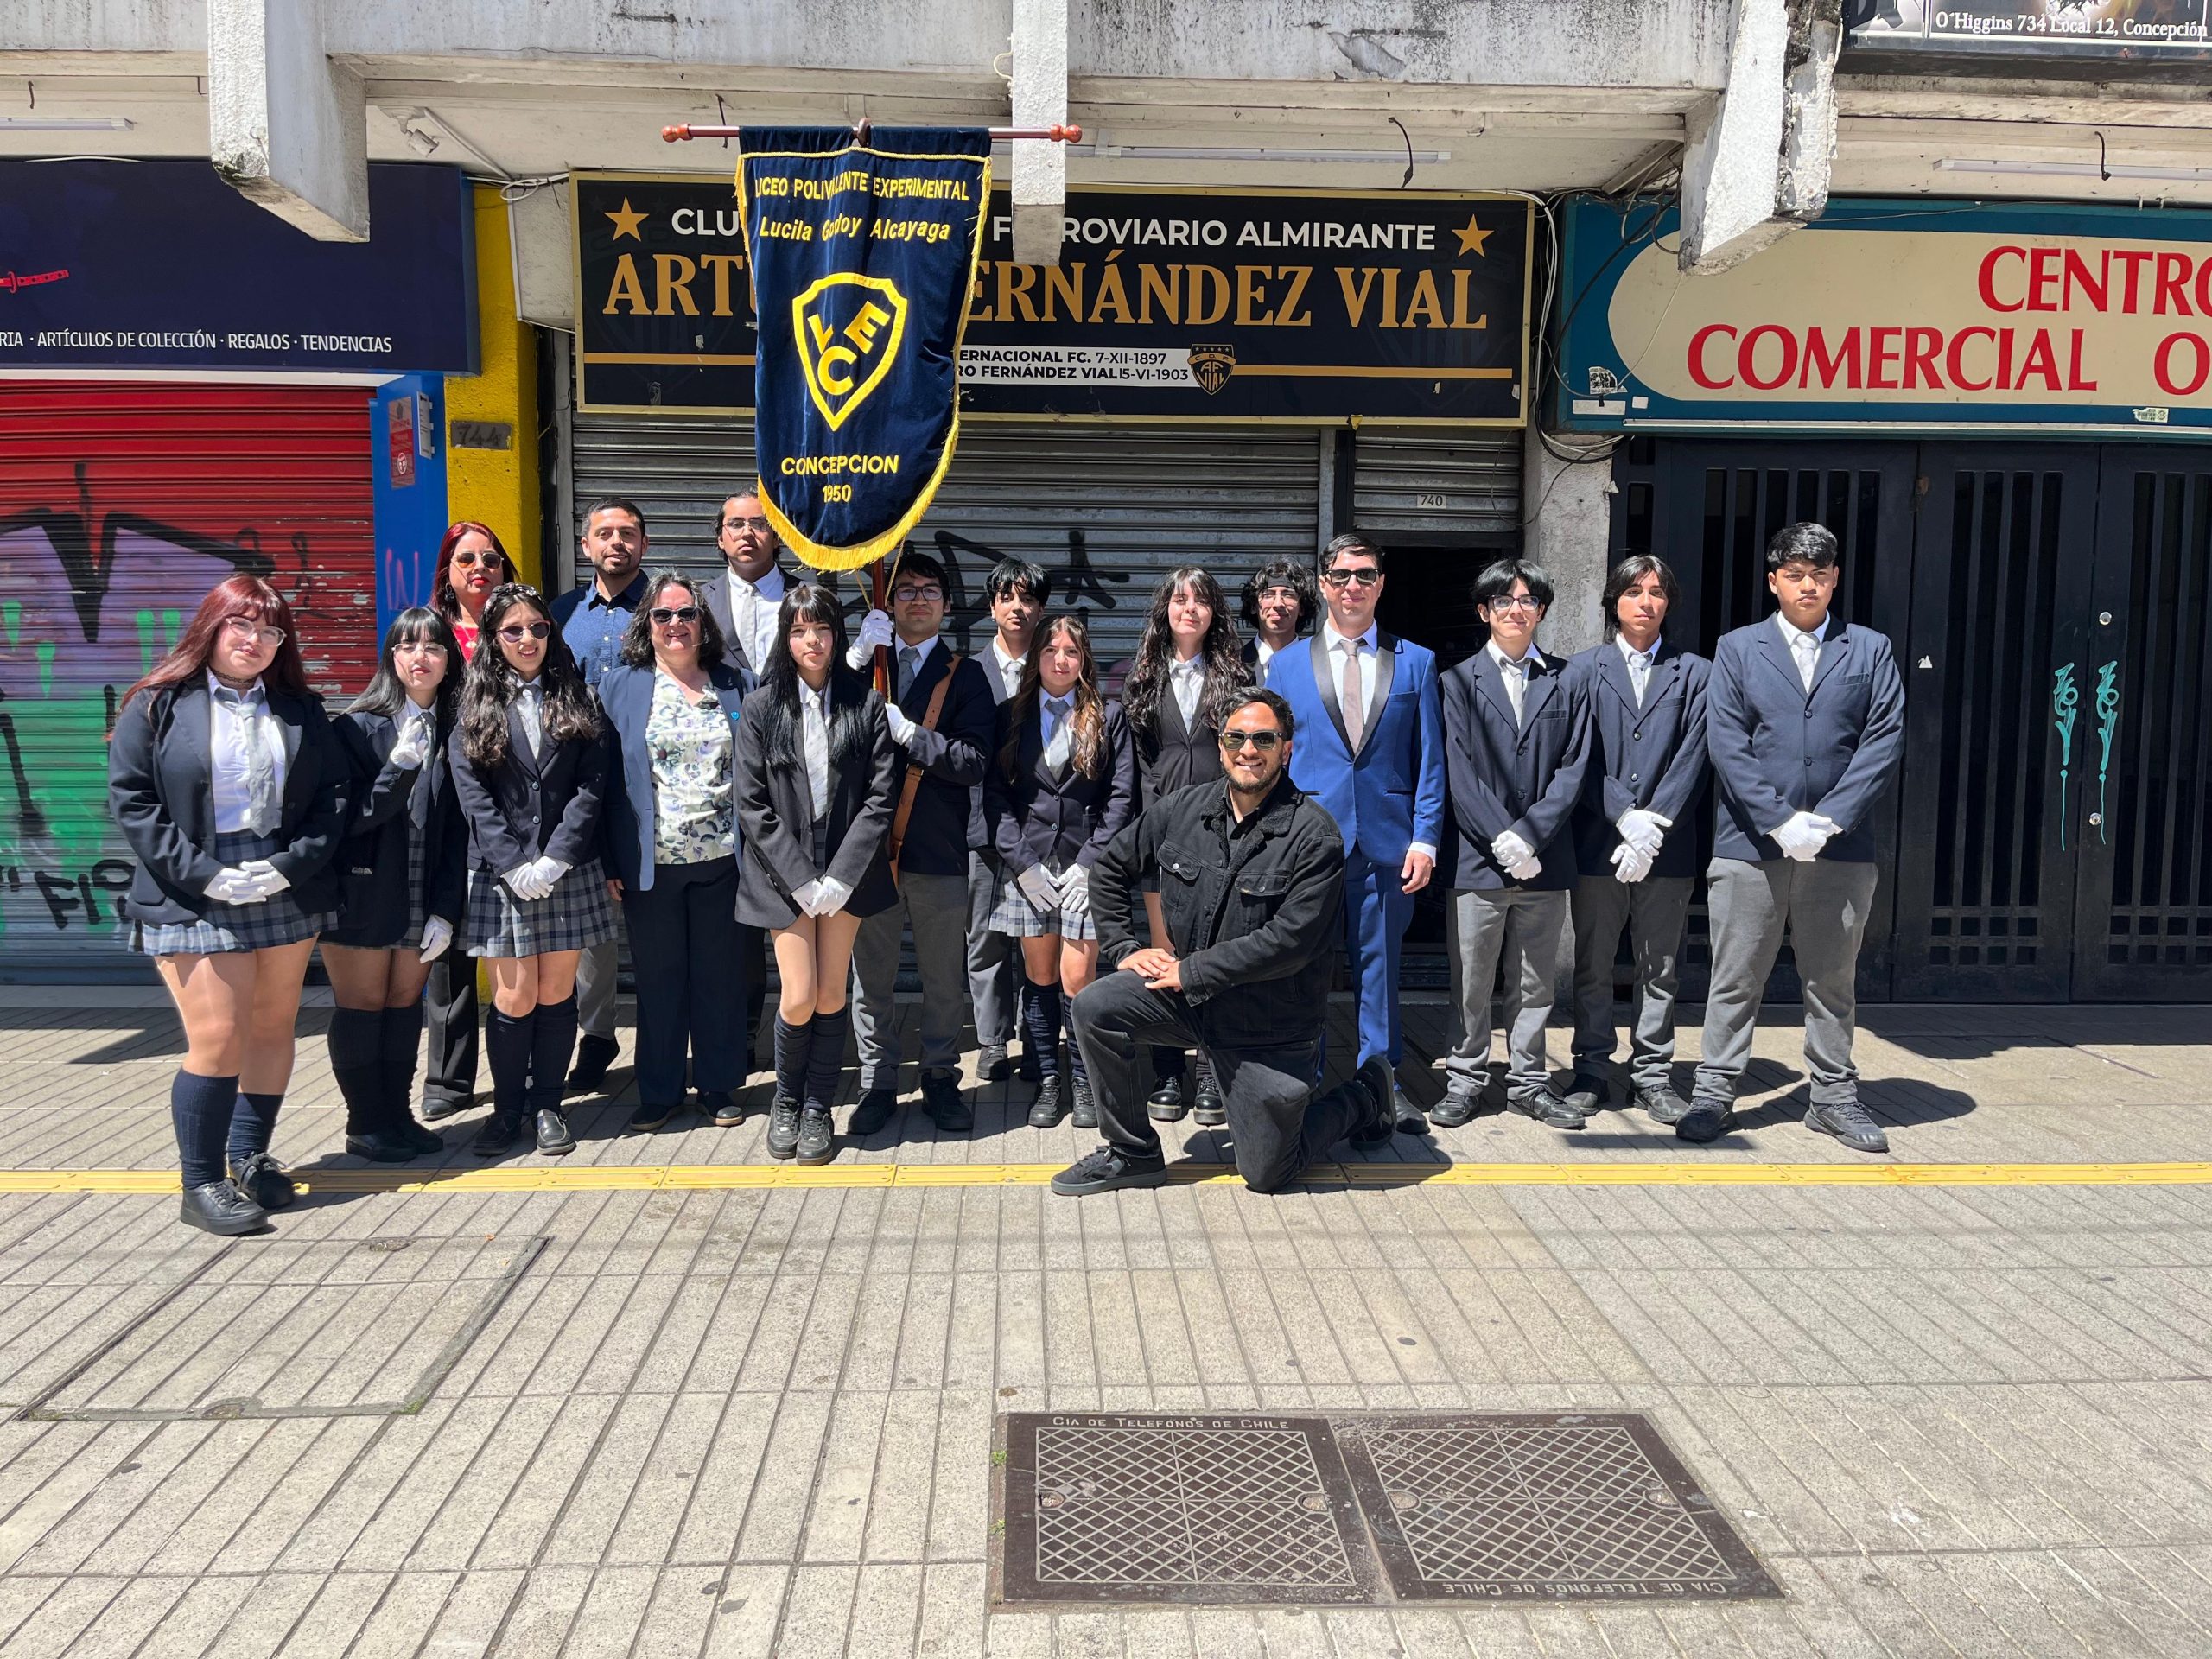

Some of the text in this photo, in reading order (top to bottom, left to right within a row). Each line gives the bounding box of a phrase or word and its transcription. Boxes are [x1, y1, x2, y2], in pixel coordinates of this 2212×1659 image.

[2018, 14, 2046, 32] 734
[2050, 15, 2091, 34] Local
[2095, 17, 2119, 36] 12,
[2123, 18, 2208, 41] Concepción
[873, 177, 969, 201] EXPERIMENTAL
[671, 208, 1435, 250] CLU FROVIARIO ALMIRANTE
[760, 213, 950, 244] Lucila Godoy Alcayaga
[602, 249, 1487, 329] ART ERNÁNDEZ VIAL
[1978, 245, 2212, 317] CENTR
[37, 328, 114, 347] ARTÍCULOS
[118, 332, 136, 347] DE
[138, 329, 216, 349] COLECCIÓN
[228, 334, 290, 350] REGALOS
[301, 335, 392, 353] TENDENCIAS
[959, 350, 1166, 365] ERNACIONAL FC. 7-XII-1897
[1688, 324, 2098, 391] COMERCIAL
[981, 364, 1077, 378] FERNÁNDEZ
[1081, 367, 1118, 379] VIAL
[781, 454, 899, 475] CONCEPCION
[822, 484, 852, 503] 1950
[1421, 494, 1443, 507] 740
[1052, 1416, 1079, 1427] CIA
[1088, 1418, 1106, 1427] DE
[1240, 1419, 1289, 1429] CHILE
